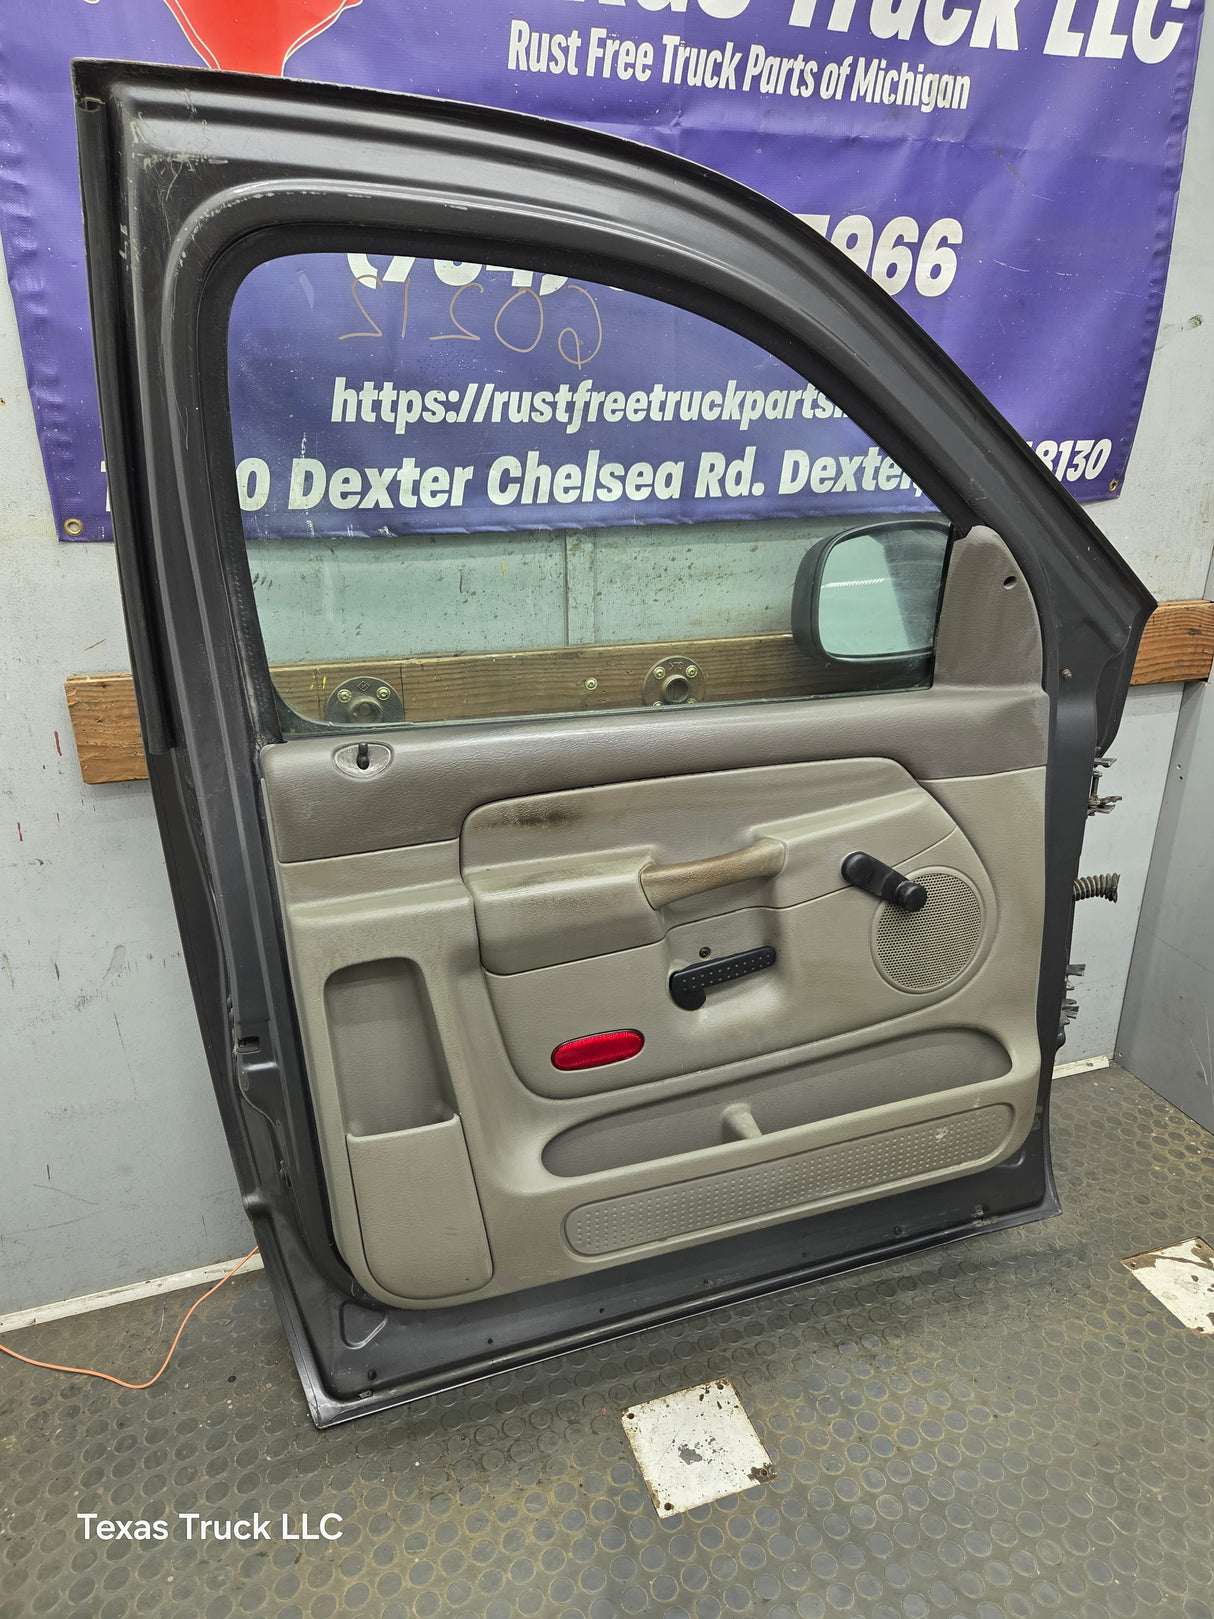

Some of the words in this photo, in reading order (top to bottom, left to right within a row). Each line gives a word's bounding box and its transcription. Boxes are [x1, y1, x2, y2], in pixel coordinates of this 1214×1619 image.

[507, 19, 582, 76] Rust
[586, 27, 654, 82] Free
[662, 34, 743, 91] Truck
[742, 44, 818, 98] Parts
[819, 56, 853, 100] of
[850, 56, 971, 113] Michigan
[1043, 0, 1191, 64] LLC
[288, 457, 474, 510] Dexter
[487, 449, 684, 506] Chelsea
[694, 446, 765, 498] Rd.
[1026, 438, 1112, 482] 8130
